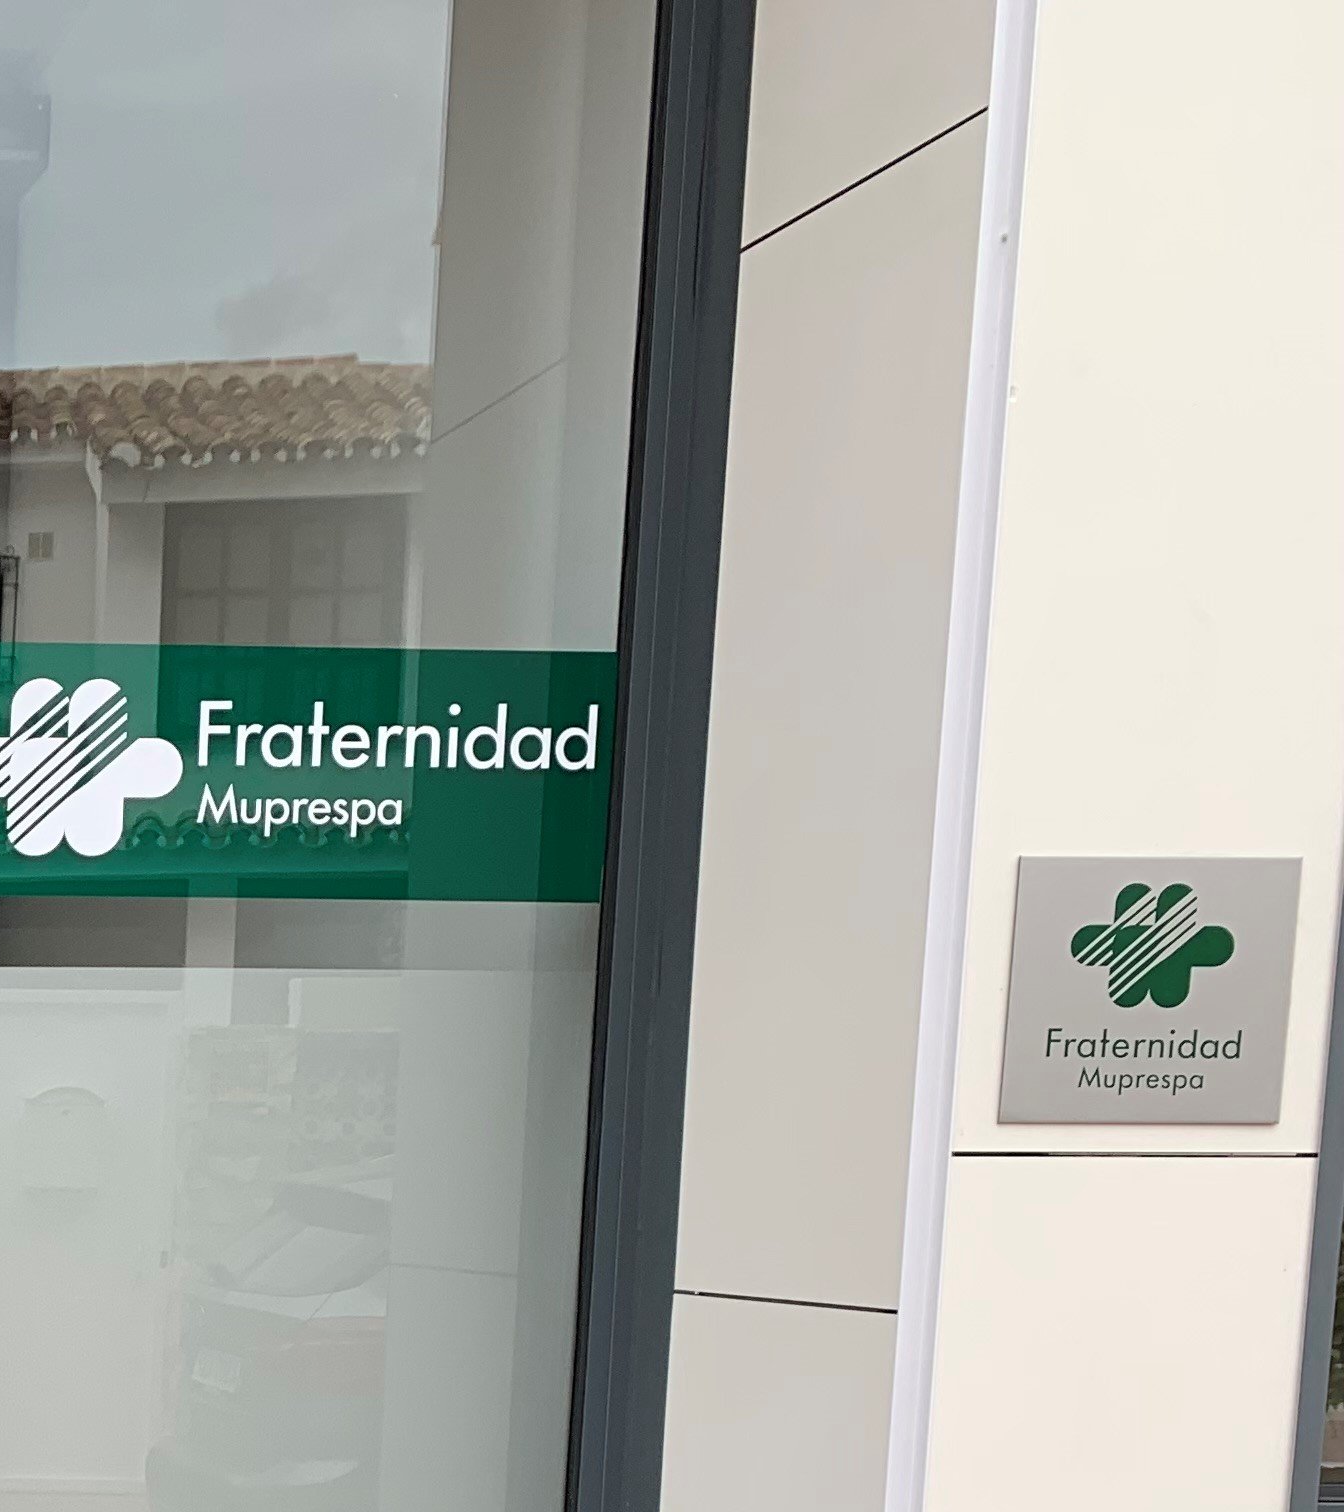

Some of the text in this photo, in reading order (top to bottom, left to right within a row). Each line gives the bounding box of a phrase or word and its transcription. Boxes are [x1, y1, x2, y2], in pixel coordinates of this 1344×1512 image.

[197, 700, 599, 770] Fraternidad
[196, 783, 403, 838] Muprespa
[1045, 1028, 1243, 1059] Fraternidad
[1077, 1066, 1205, 1096] Muprespa
